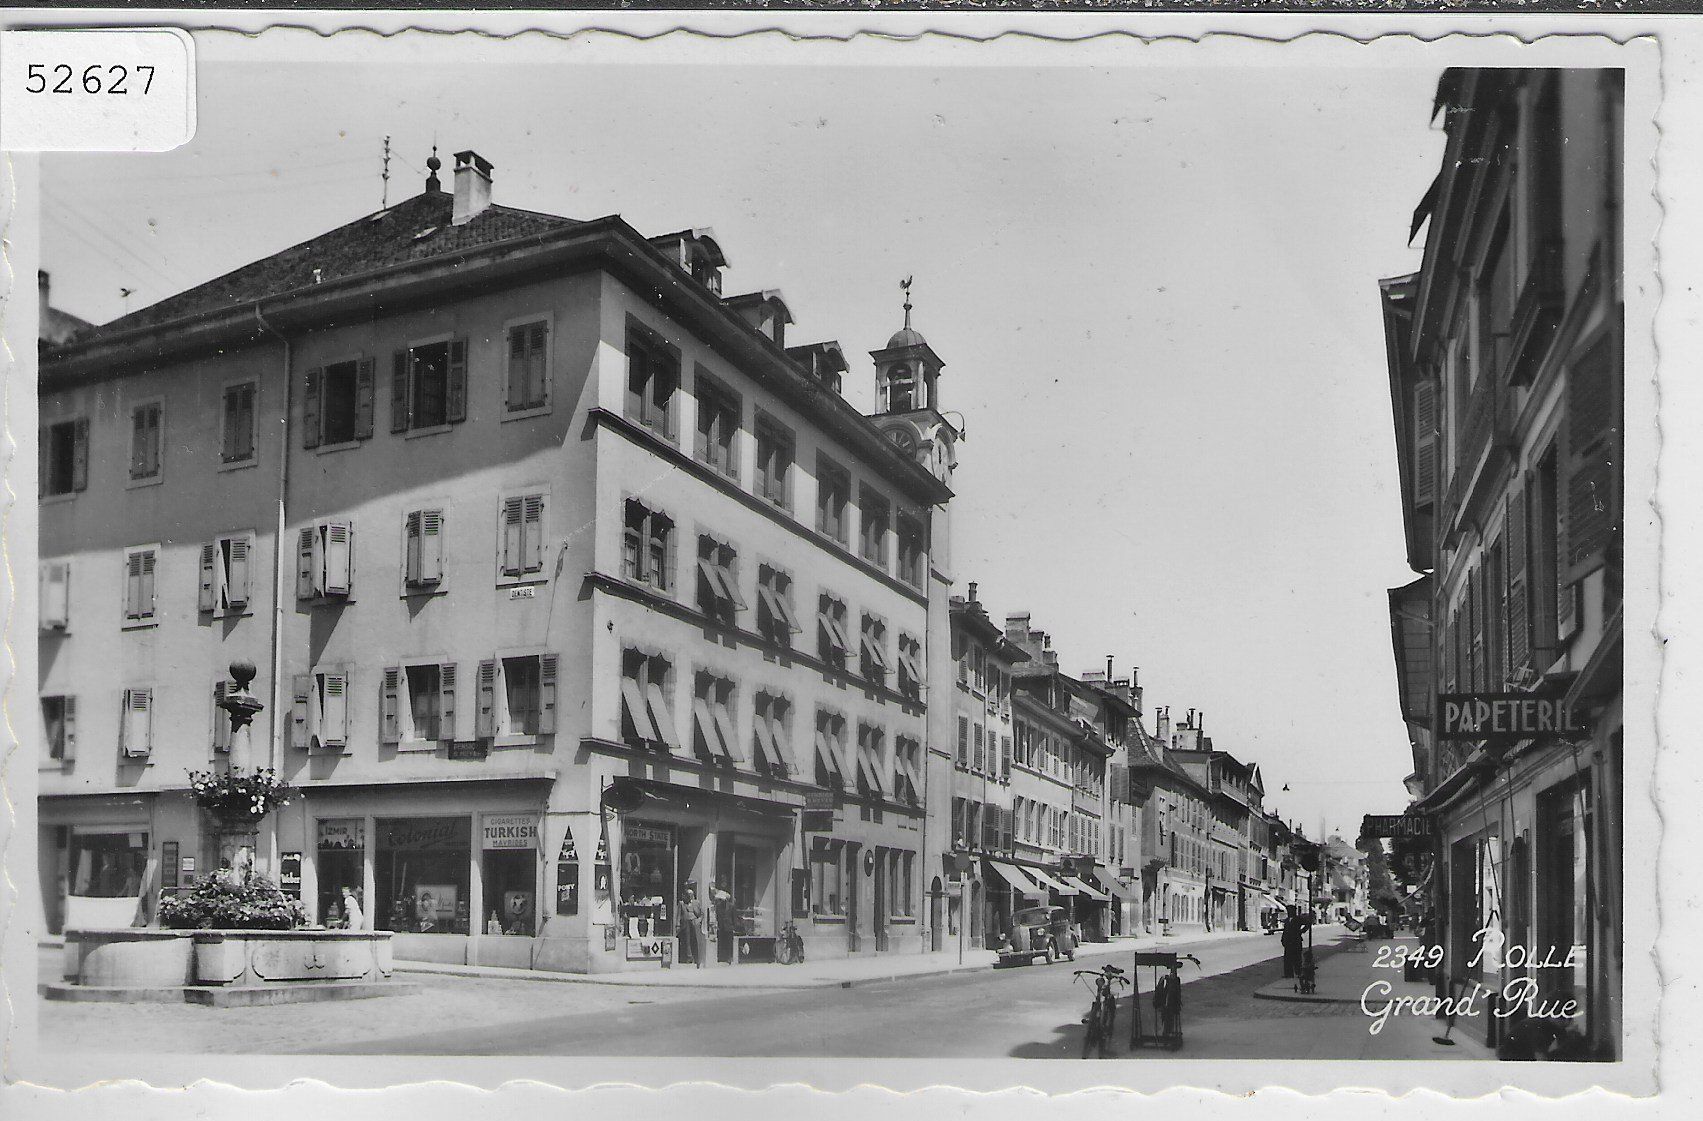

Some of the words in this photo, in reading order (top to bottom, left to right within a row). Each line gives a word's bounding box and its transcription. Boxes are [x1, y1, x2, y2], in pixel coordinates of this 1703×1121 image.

[485, 826, 537, 839] TURKISH
[1367, 817, 1432, 836] PHARMACIE
[649, 829, 670, 841] STATE
